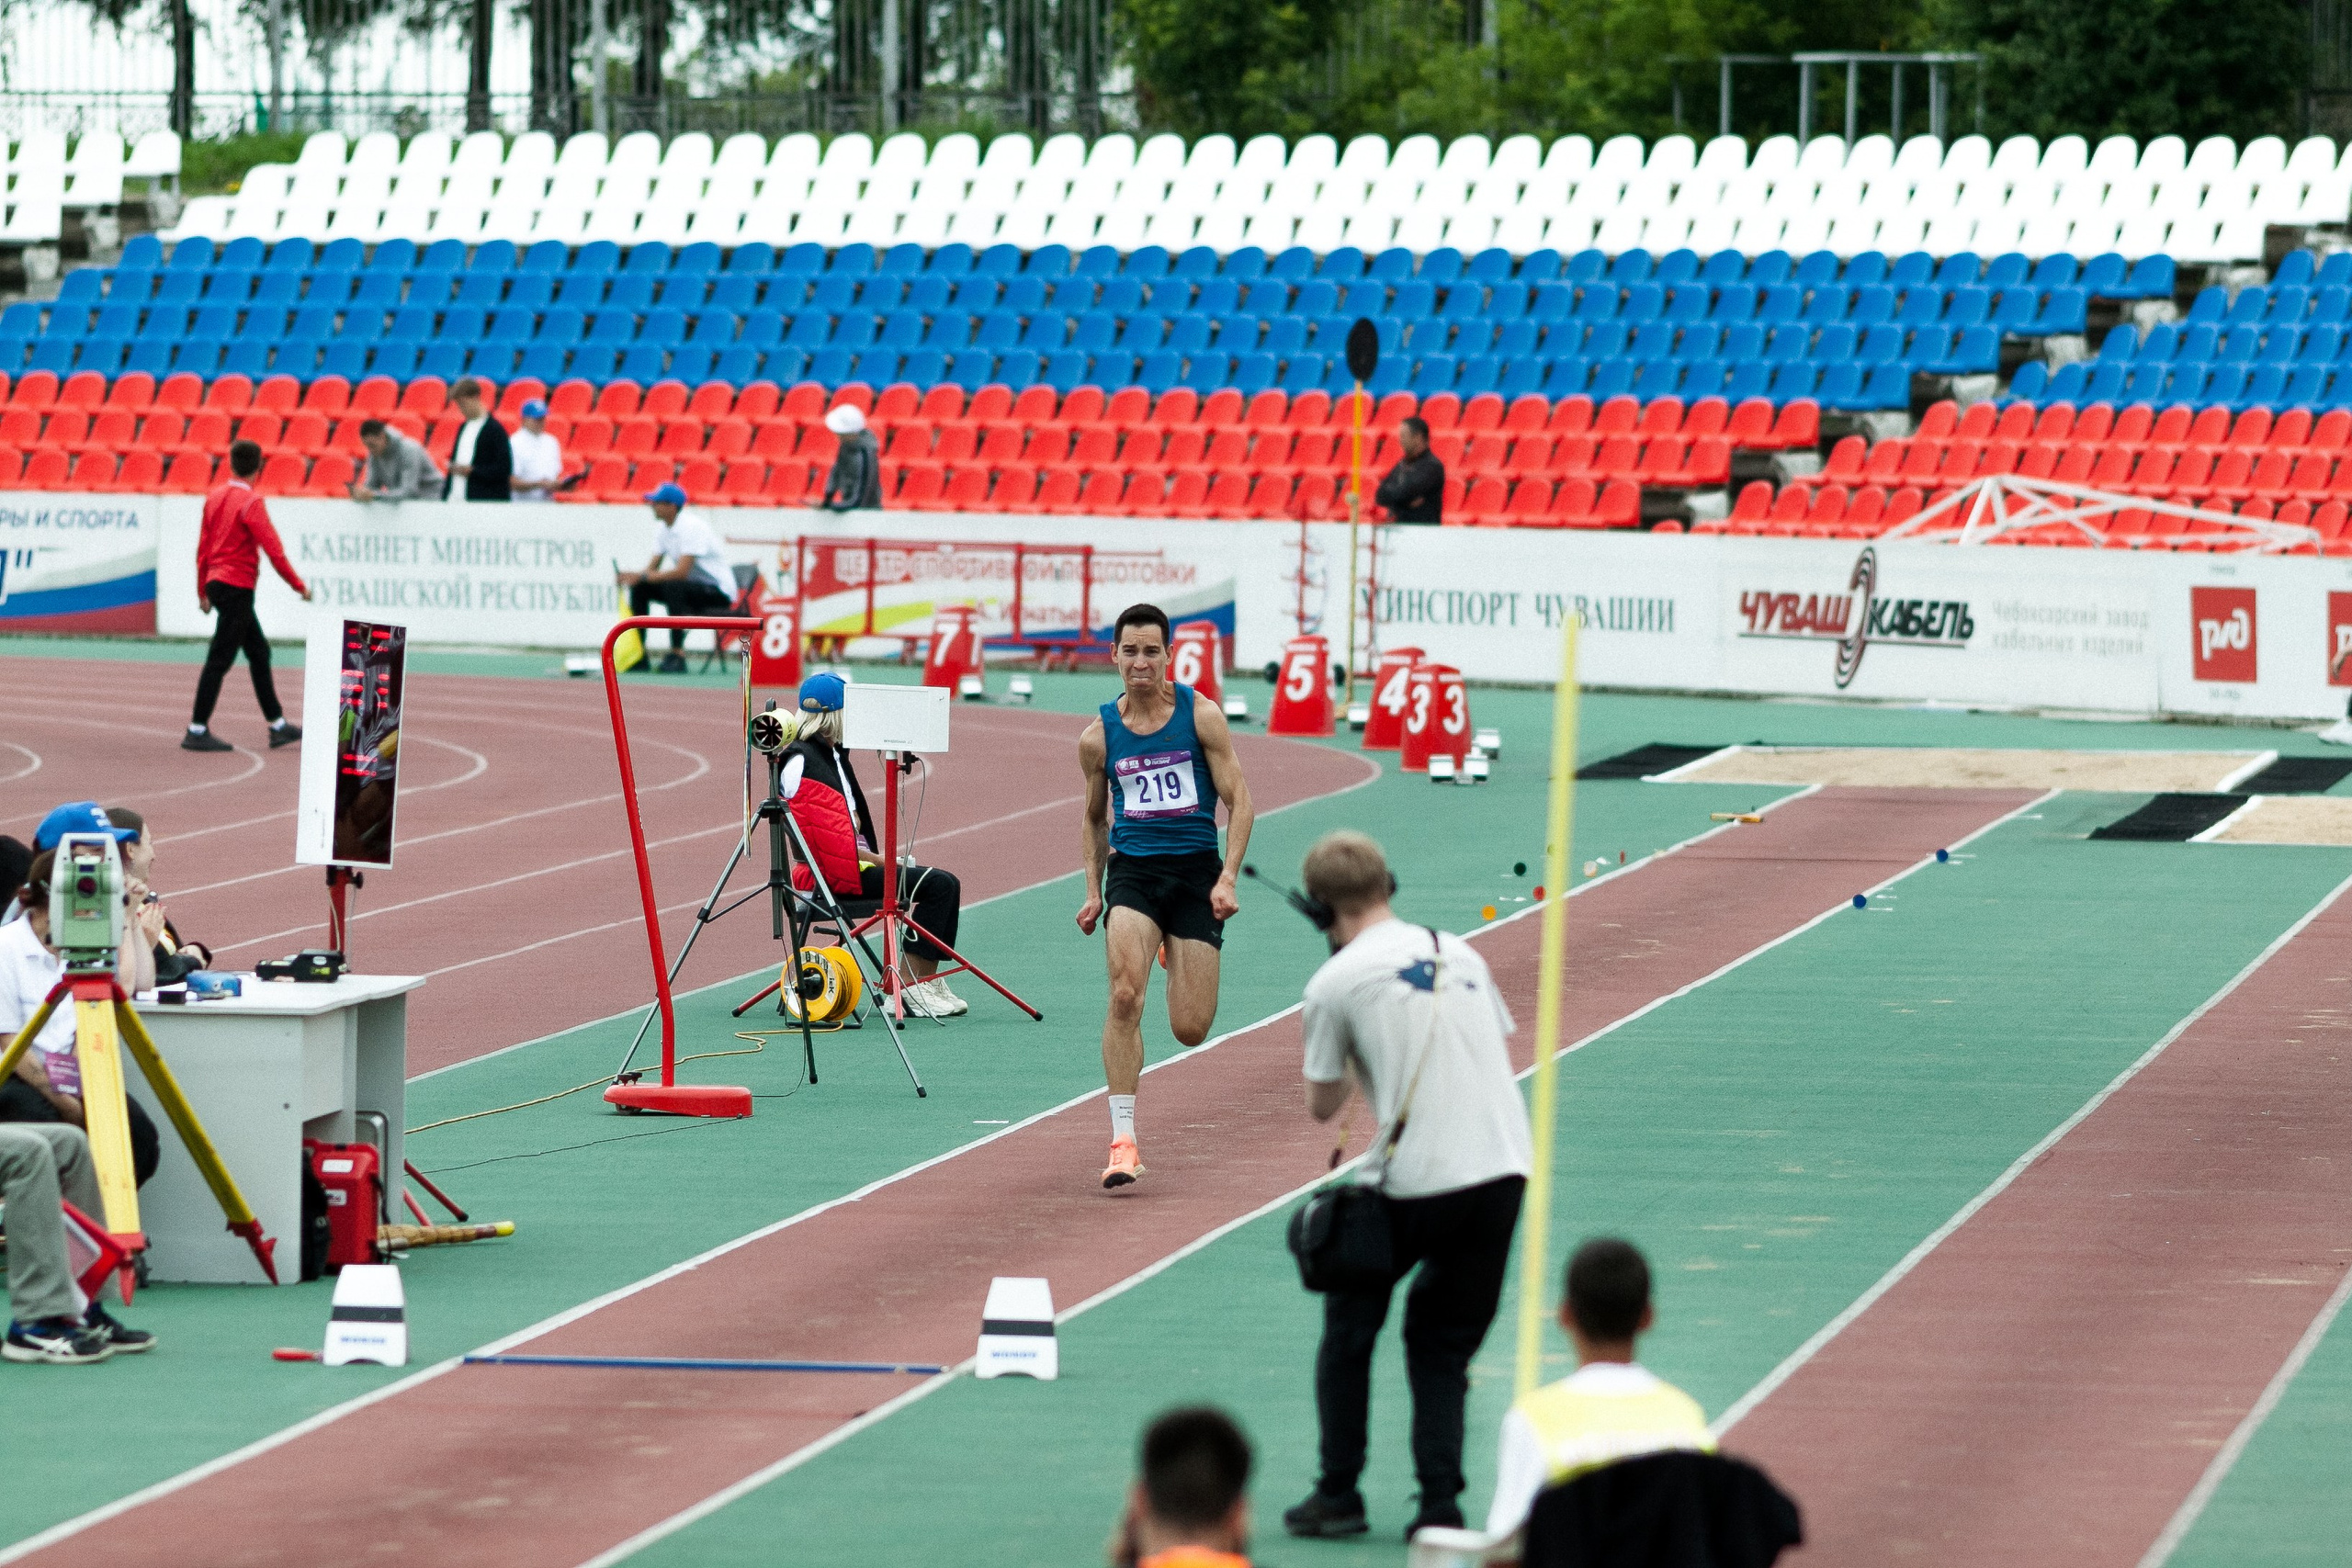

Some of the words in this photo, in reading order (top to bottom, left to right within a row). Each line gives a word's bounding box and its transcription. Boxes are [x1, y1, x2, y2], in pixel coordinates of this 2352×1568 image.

[34, 509, 50, 527] И
[55, 509, 139, 530] СПОРТА
[300, 533, 422, 565] КАБИНЕТ
[432, 536, 594, 569] МИНИСТРОВ
[761, 615, 793, 660] 8
[933, 623, 960, 667] 7
[1175, 641, 1204, 687] 6
[1286, 654, 1316, 701] 5
[1378, 667, 1410, 716] 4
[1407, 683, 1431, 734] 3
[1442, 684, 1464, 734] 3
[1135, 771, 1182, 804] 219
